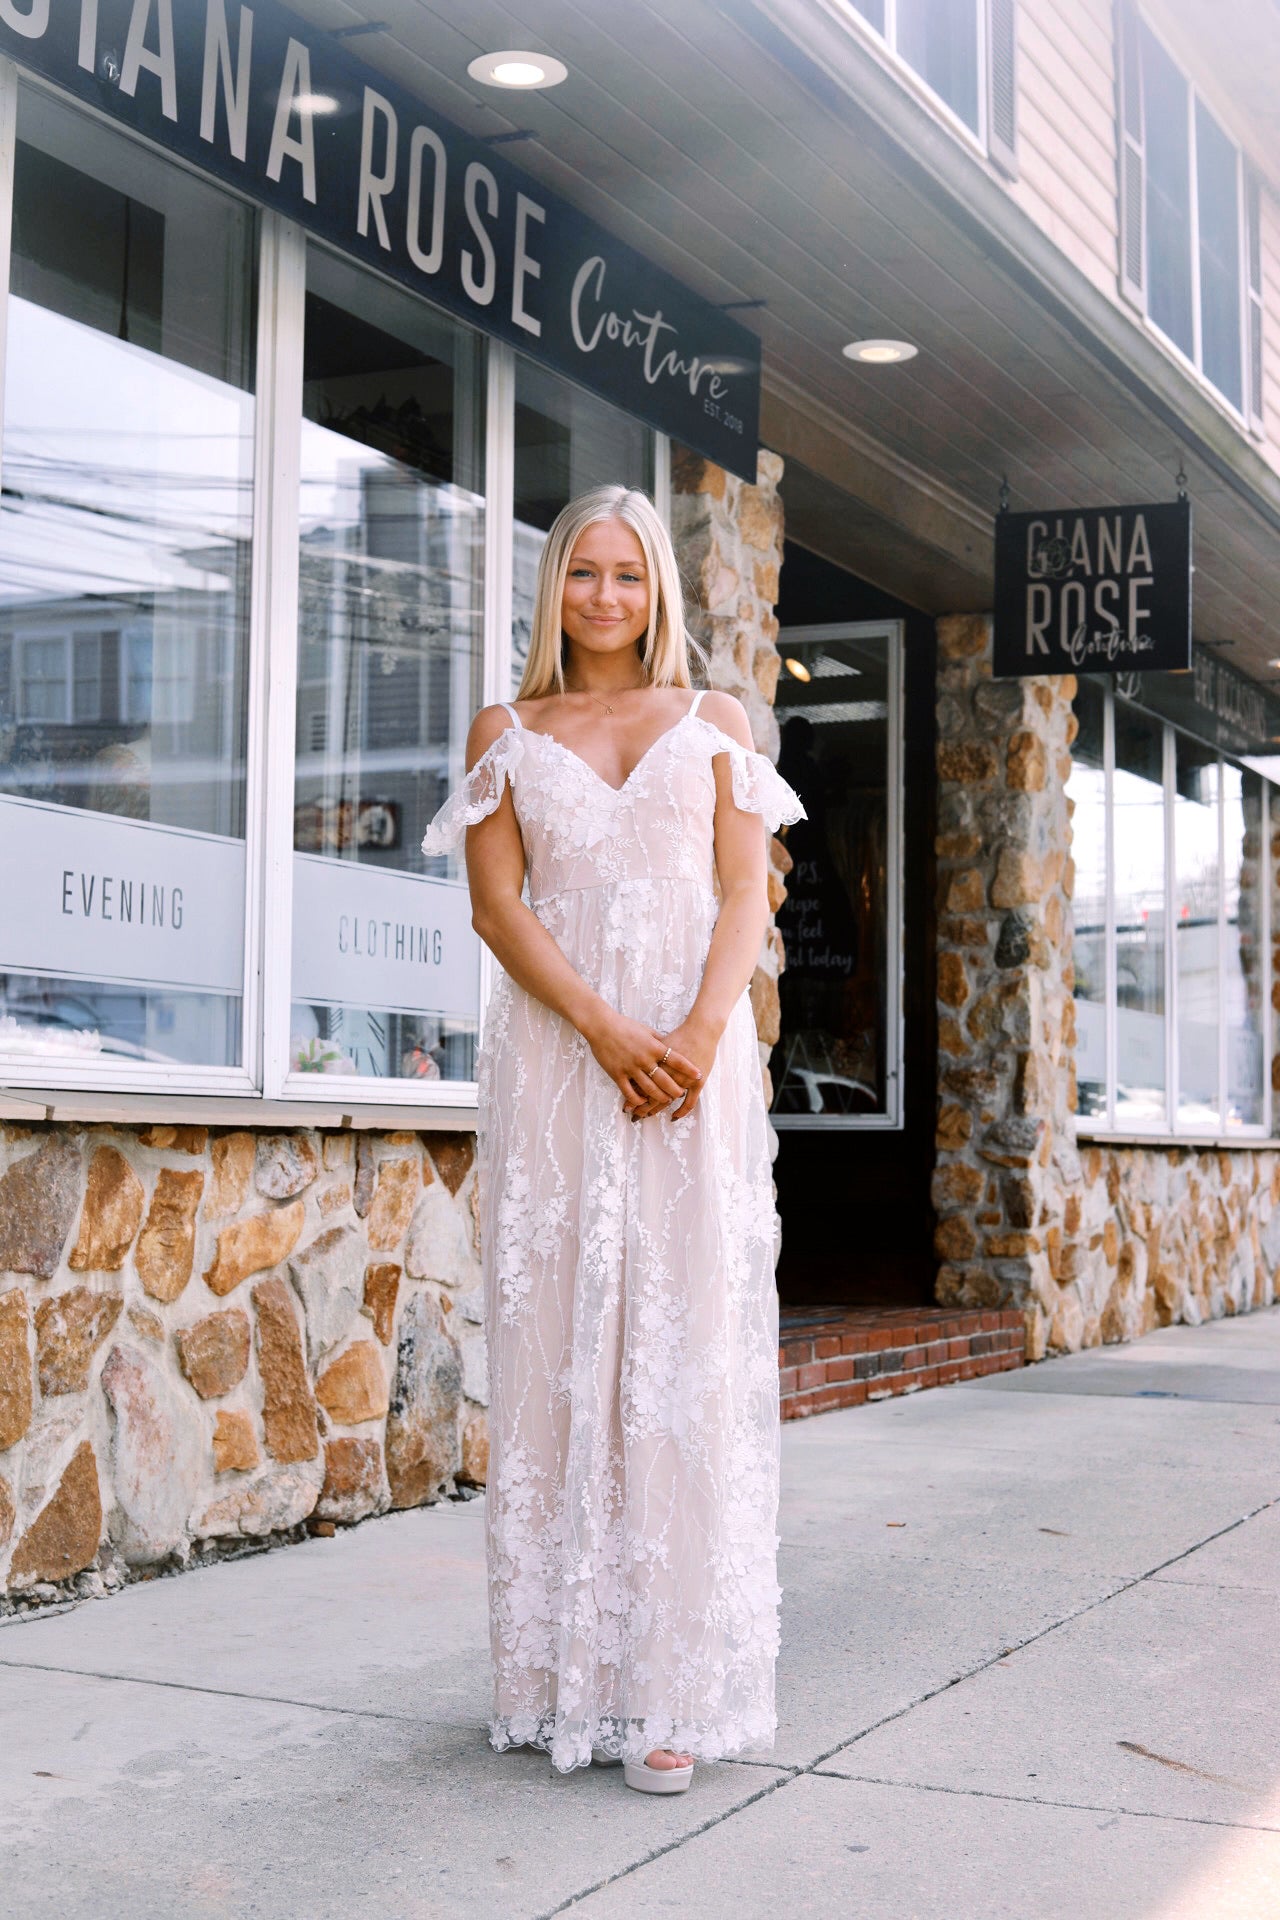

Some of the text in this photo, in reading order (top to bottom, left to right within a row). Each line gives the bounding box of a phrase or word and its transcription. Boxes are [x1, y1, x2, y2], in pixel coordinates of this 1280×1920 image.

[0, 0, 729, 399] ANA ROSE Couture
[704, 399, 721, 421] EST.
[1026, 577, 1154, 656] ROSE
[62, 870, 184, 930] EVENING
[338, 915, 442, 965] CLOTHING
[808, 944, 852, 974] today
